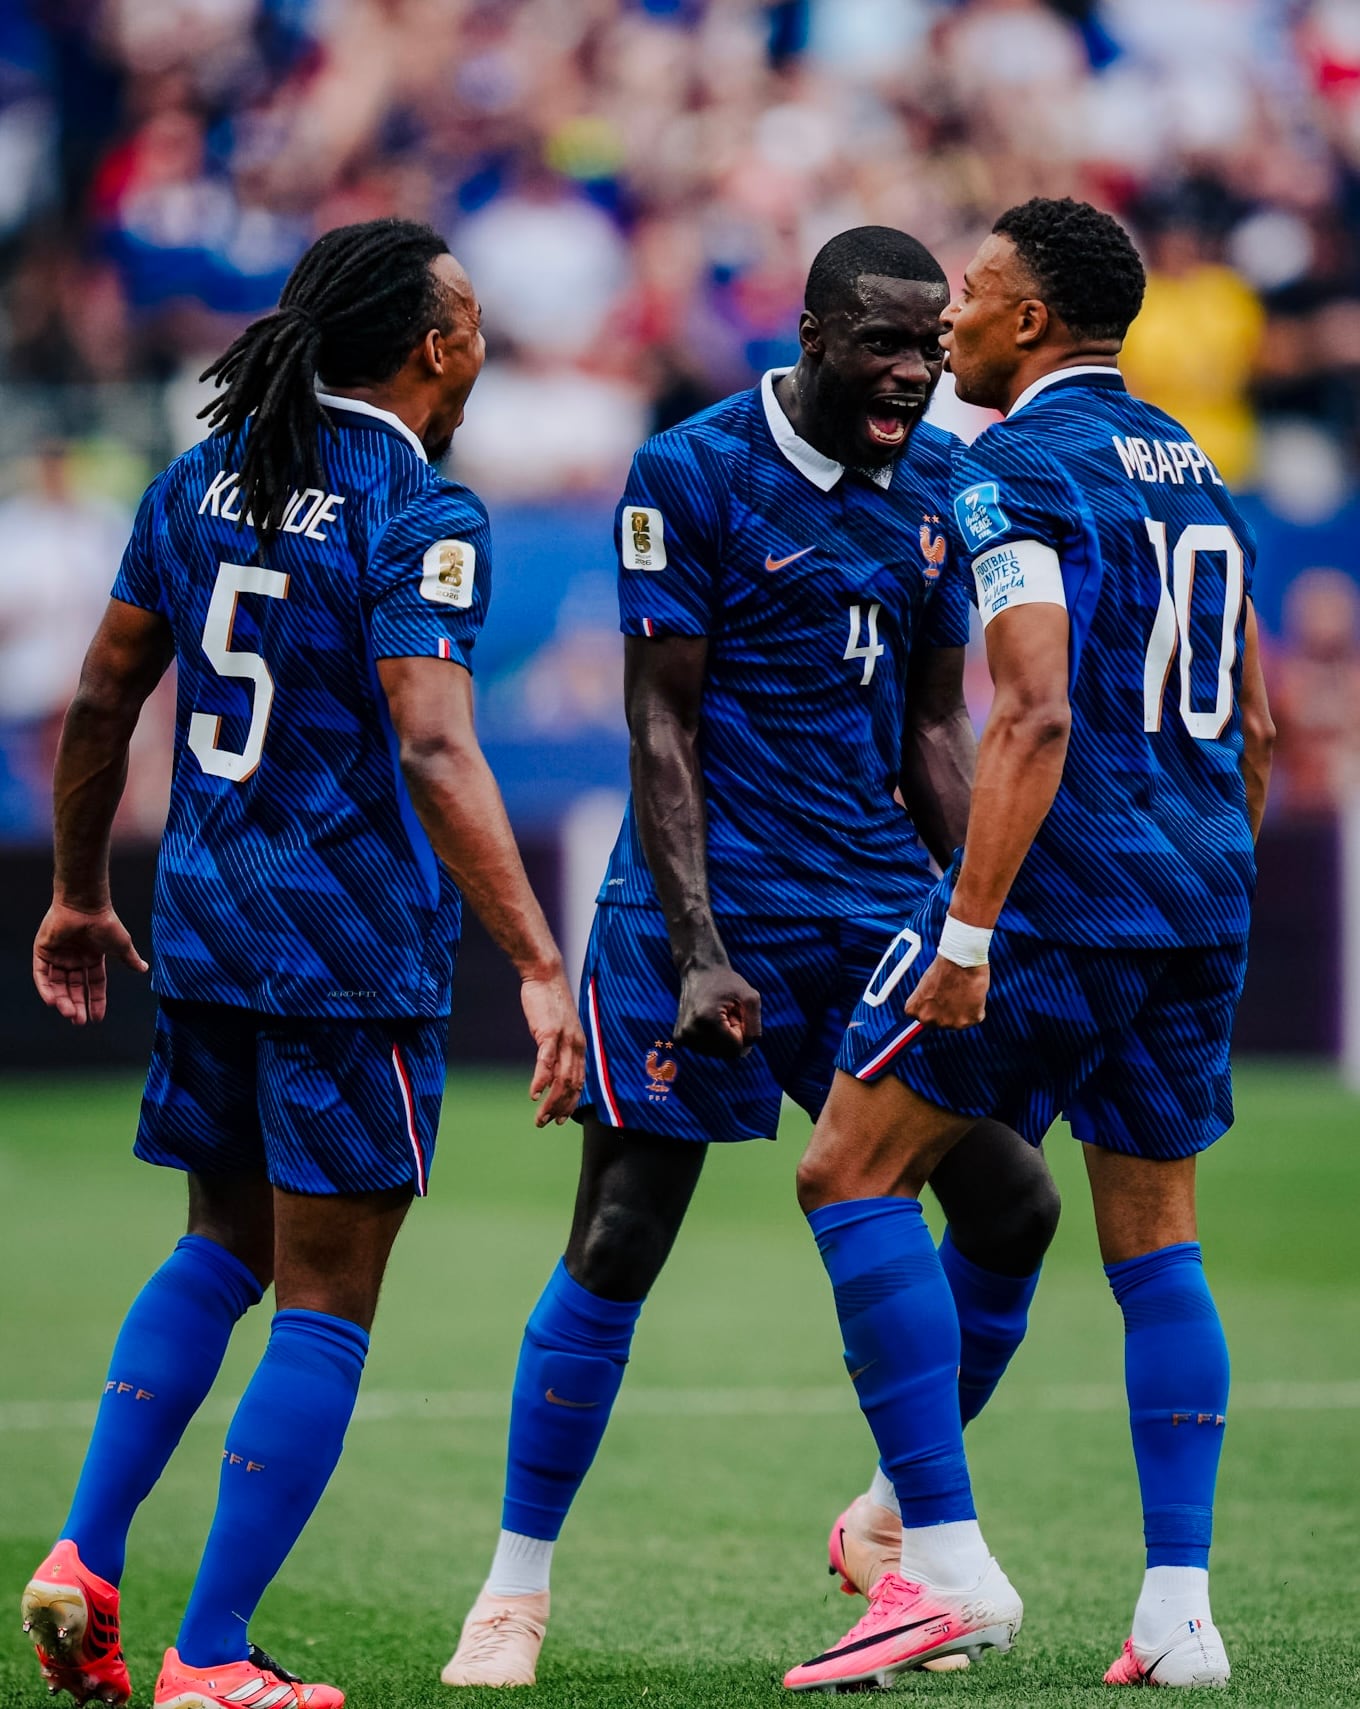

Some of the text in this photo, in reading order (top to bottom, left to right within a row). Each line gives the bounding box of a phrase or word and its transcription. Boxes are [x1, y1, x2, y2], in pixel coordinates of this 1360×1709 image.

[975, 549, 1018, 577] FOOTBALL
[981, 560, 1021, 593] UNITES
[842, 603, 885, 686] 4
[1143, 516, 1244, 739] 10
[187, 561, 290, 783] 5
[104, 1380, 156, 1401] FFF
